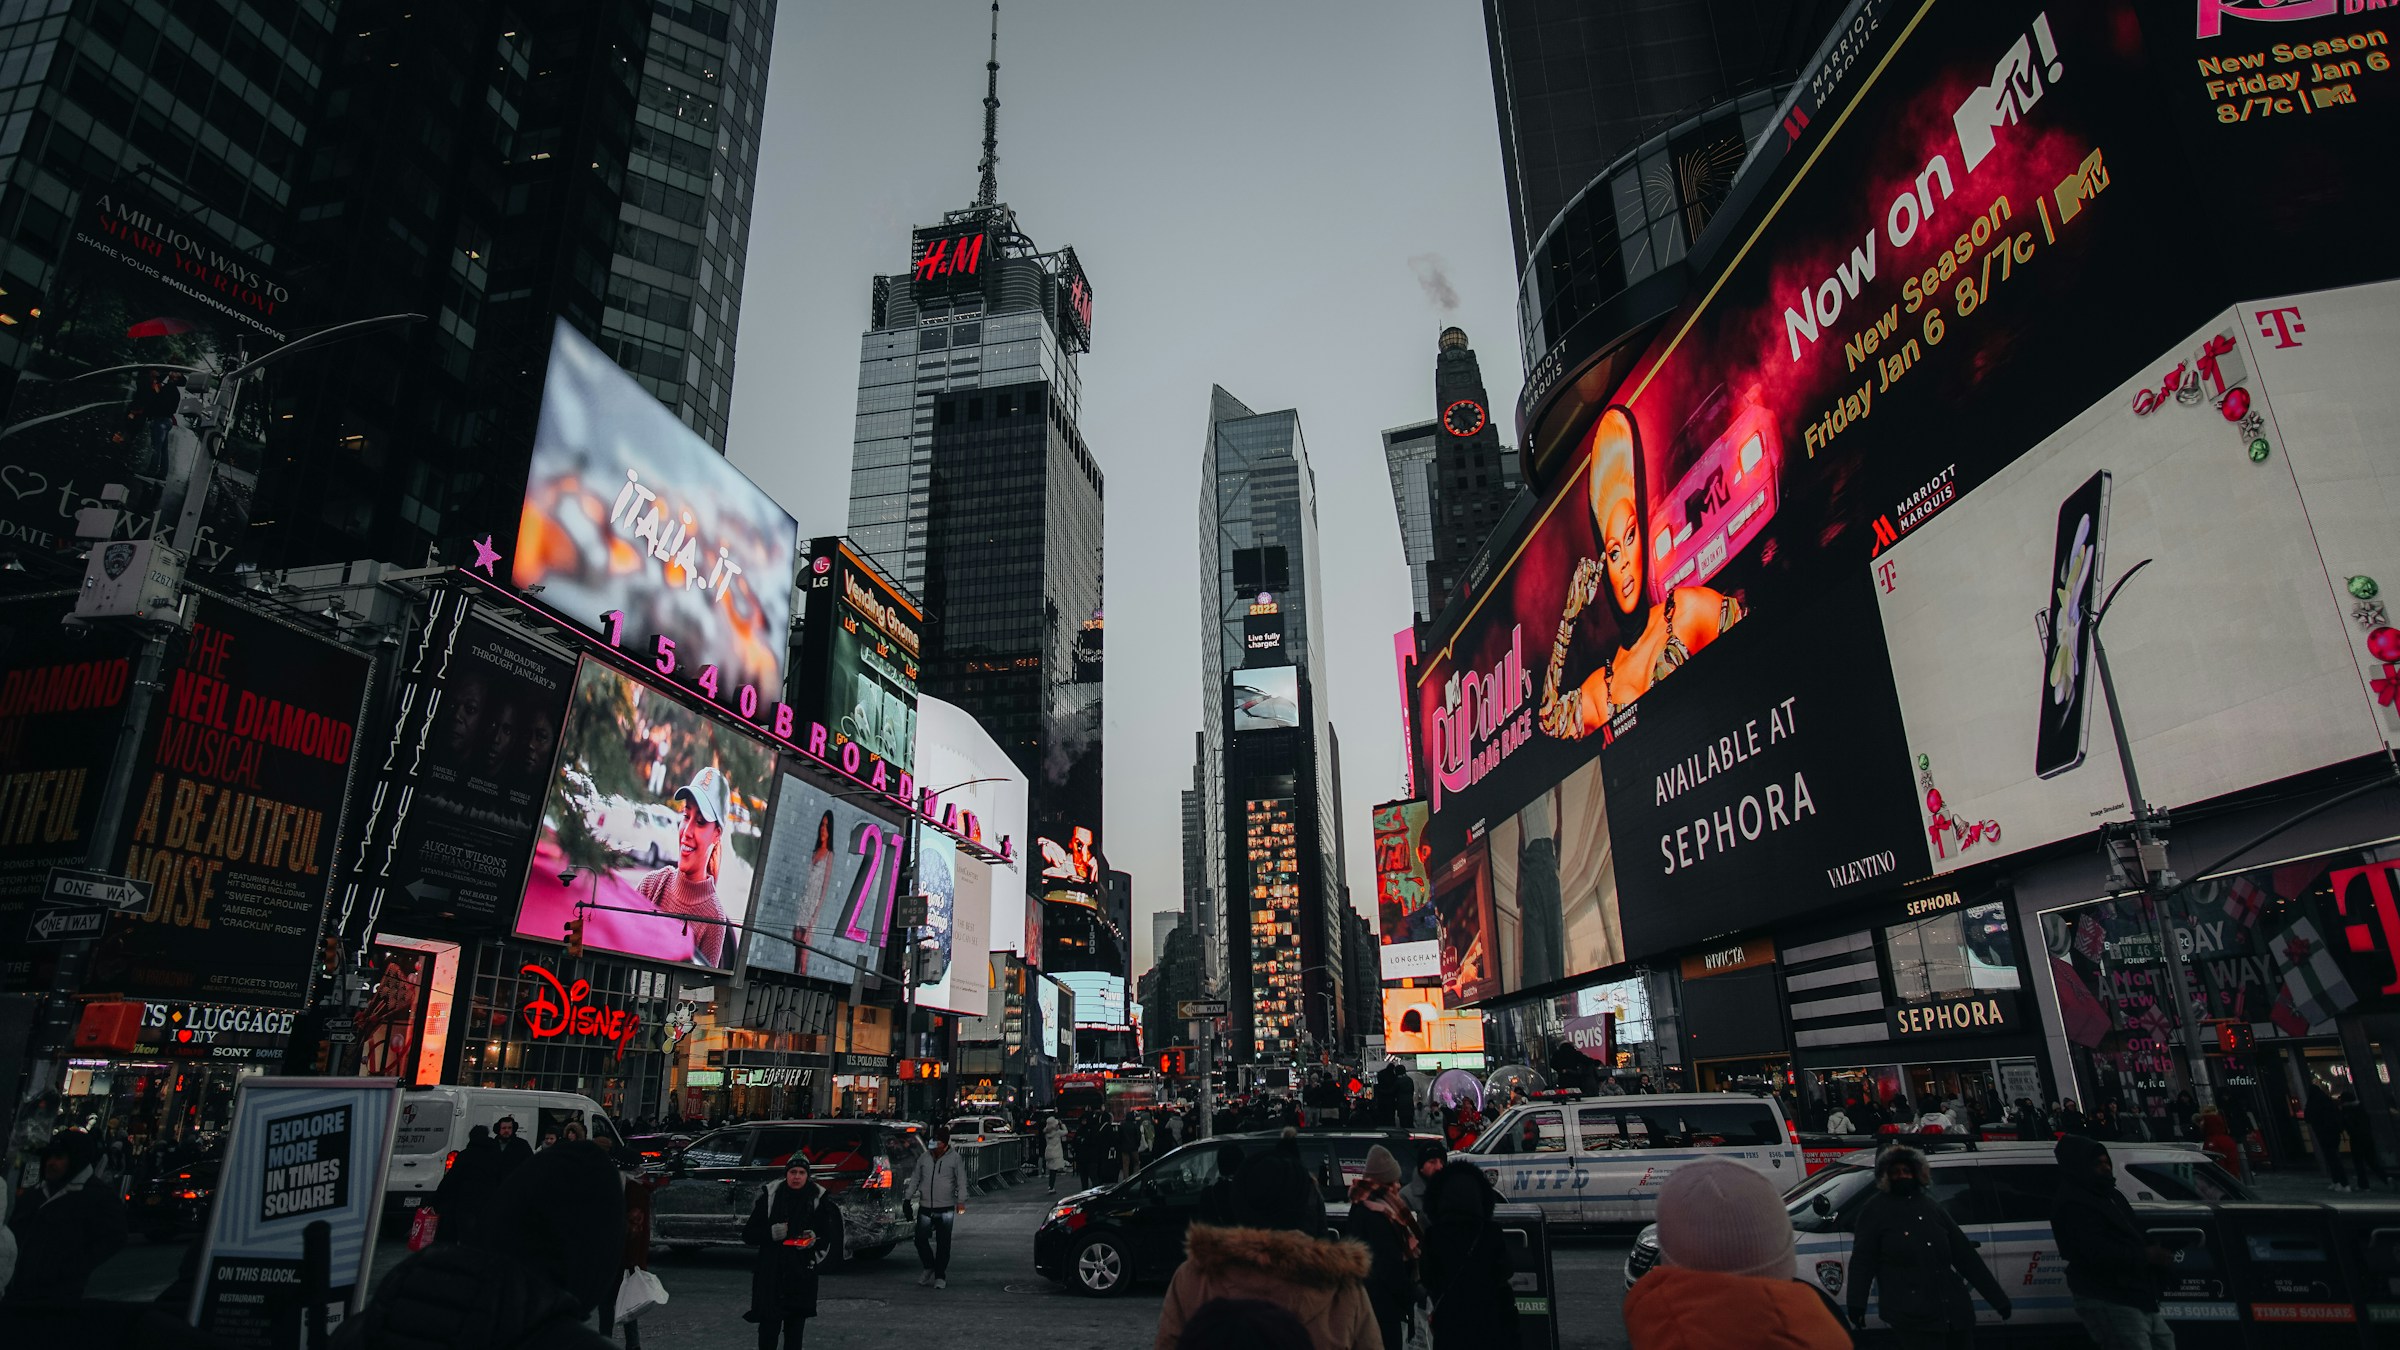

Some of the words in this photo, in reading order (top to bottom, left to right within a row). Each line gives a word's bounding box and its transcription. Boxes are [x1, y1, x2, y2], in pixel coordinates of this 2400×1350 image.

[1812, 0, 1881, 94] MARRIOT
[2197, 52, 2265, 77] New
[2271, 29, 2389, 64] Season
[2206, 69, 2300, 101] Friday
[2311, 59, 2362, 84] Jan
[2366, 51, 2391, 72] 6
[2216, 96, 2294, 124] 8/7c
[2311, 83, 2357, 109] MTV
[1783, 228, 1876, 363] Now
[1887, 154, 1955, 248] on
[1953, 11, 2064, 175] MTV!
[97, 194, 110, 212] A
[117, 203, 206, 260] MILLION
[210, 251, 260, 289] WAYS
[265, 279, 288, 303] TO
[915, 233, 984, 282] H&M
[77, 232, 119, 258] SHARE
[120, 253, 160, 279] YOURS
[161, 274, 286, 342] #MILLIONWAYSTOLOVE
[1844, 304, 1899, 373] New
[1902, 195, 2012, 314] Season
[1071, 274, 1091, 331] H&M
[1803, 379, 1873, 460] Friday
[1878, 337, 1922, 394] Jan
[1922, 307, 1945, 347] 6
[1955, 231, 2036, 318] 8/7c
[2054, 146, 2110, 225] MTV
[1523, 339, 1567, 402] MARRIOTT
[1525, 362, 1563, 417] MARQUIS
[1685, 463, 1732, 535] MTV
[1897, 463, 1956, 516] MARRIOTT
[1900, 485, 1953, 531] MARQUIS
[812, 576, 829, 588] LG
[1250, 602, 1278, 616] 2022
[188, 623, 236, 680] THE
[1248, 634, 1263, 642] Live
[1264, 632, 1280, 642] fully
[1248, 639, 1280, 649] charged.
[471, 645, 512, 671] THROUGH
[513, 664, 549, 688] JANUARY
[547, 680, 557, 691] 29
[489, 642, 503, 654] ON
[503, 648, 547, 675] BROADWAY
[168, 667, 230, 730] NEIL
[234, 689, 353, 766] DIAMOND
[604, 608, 759, 720] 1540
[773, 702, 979, 839] BROADWAY
[1612, 703, 1638, 728] MARRIOTT
[1614, 717, 1637, 738] MARQUIS
[155, 716, 265, 791] MUSICAL
[1471, 738, 1500, 785] DRAG
[1501, 708, 1532, 760] RACE
[1656, 719, 1761, 808] AVAILABLE
[1770, 696, 1796, 745] AT
[134, 771, 166, 845] A
[164, 776, 325, 876] BEAUTIFUL
[1661, 771, 1816, 875] SEPHORA
[419, 849, 441, 861] THE
[442, 854, 471, 871] PIANO
[473, 861, 507, 878] LESSON
[422, 839, 464, 858] AUGUST
[465, 849, 508, 869] WILSON'S
[1827, 849, 1896, 889] VALENTINO
[63, 880, 94, 897] ONE
[106, 885, 136, 902] WAY
[227, 878, 239, 887] HIT
[240, 882, 267, 893] SONGS
[267, 885, 306, 899] INCLUDING
[229, 871, 271, 885] FEATURING
[271, 878, 284, 889] ALL
[285, 880, 297, 890] HIS
[842, 823, 905, 949] 21
[1906, 890, 1962, 916] SEPHORA
[41, 917, 62, 931] ONE
[72, 915, 97, 929] WAY
[1705, 945, 1745, 971] INVICTA
[2121, 946, 2132, 957] W
[2135, 945, 2151, 957] 46
[210, 975, 229, 985] GET
[231, 976, 266, 988] TICKETS
[268, 979, 299, 990] TODAY!
[185, 1006, 295, 1035] LUGGAGE
[741, 981, 837, 1035] FOREVER
[1207, 1005, 1221, 1013] WAY
[1896, 998, 2004, 1034] SEPHORA
[170, 1029, 180, 1042] I
[192, 1030, 219, 1044] NY
[212, 1047, 253, 1058] SONY
[255, 1048, 284, 1059] BOWER
[762, 1067, 801, 1086] FOREVER
[801, 1069, 812, 1087] 21
[846, 1054, 857, 1065] U.S.
[857, 1055, 873, 1066] POLO
[269, 1110, 345, 1146] EXPLORE
[268, 1139, 319, 1169] MORE
[266, 1168, 286, 1193] IN
[289, 1157, 341, 1189] TIMES
[1513, 1169, 1590, 1191] NYPD
[264, 1183, 337, 1218] SQUARE
[217, 1266, 235, 1281] ON
[235, 1266, 260, 1281] THIS
[260, 1268, 302, 1284] BLOCK...
[219, 1292, 265, 1305] RESTAURANTS
[2185, 1302, 2236, 1317] SQUARE
[2255, 1303, 2296, 1318] TIMES
[2300, 1303, 2352, 1318] SQUARE
